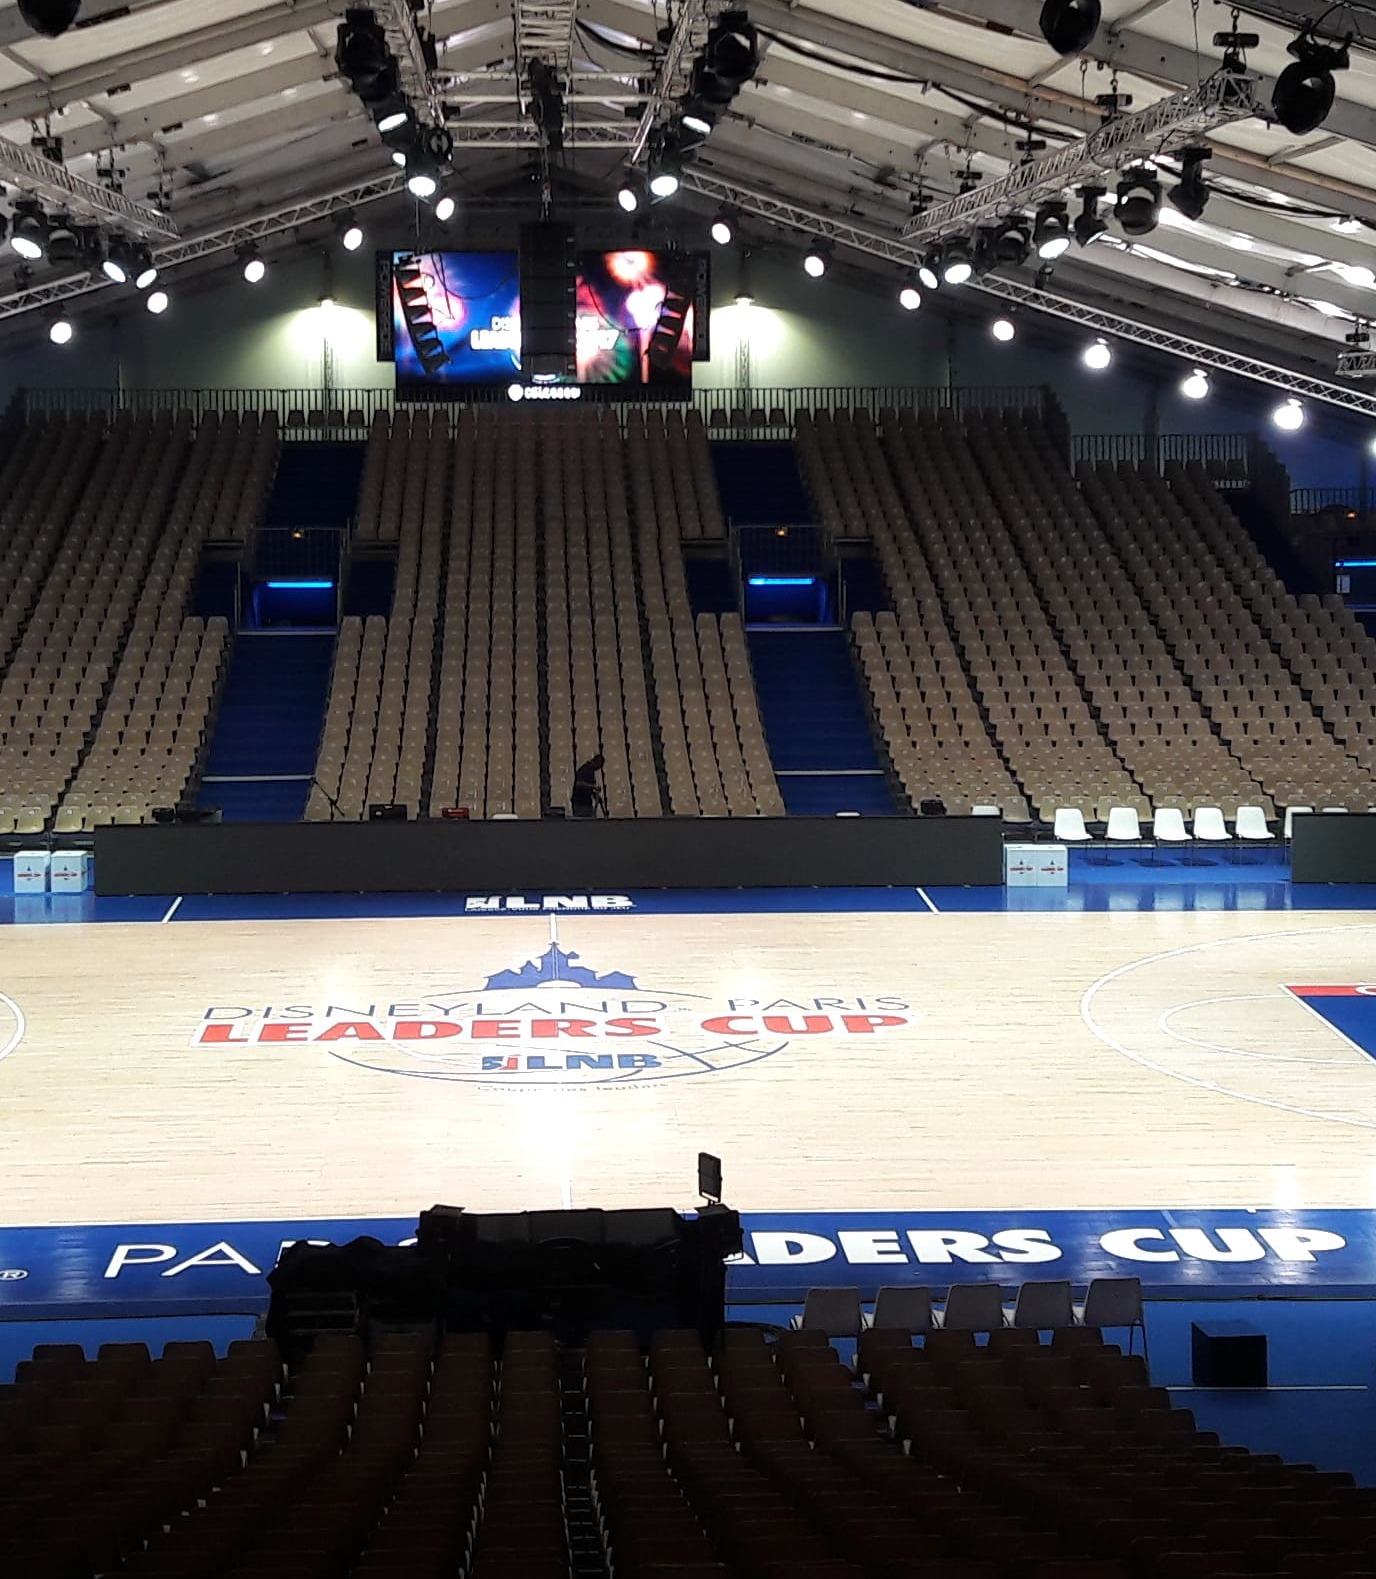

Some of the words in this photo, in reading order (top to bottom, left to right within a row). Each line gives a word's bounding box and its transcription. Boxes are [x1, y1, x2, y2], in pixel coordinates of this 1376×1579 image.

[506, 895, 634, 908] LNB
[727, 996, 910, 1011] PARIS
[199, 1017, 662, 1043] LEADERS
[701, 1014, 909, 1035] CUP
[527, 1053, 662, 1071] LNB
[724, 1229, 1064, 1265] DERS
[1099, 1227, 1347, 1264] CUP
